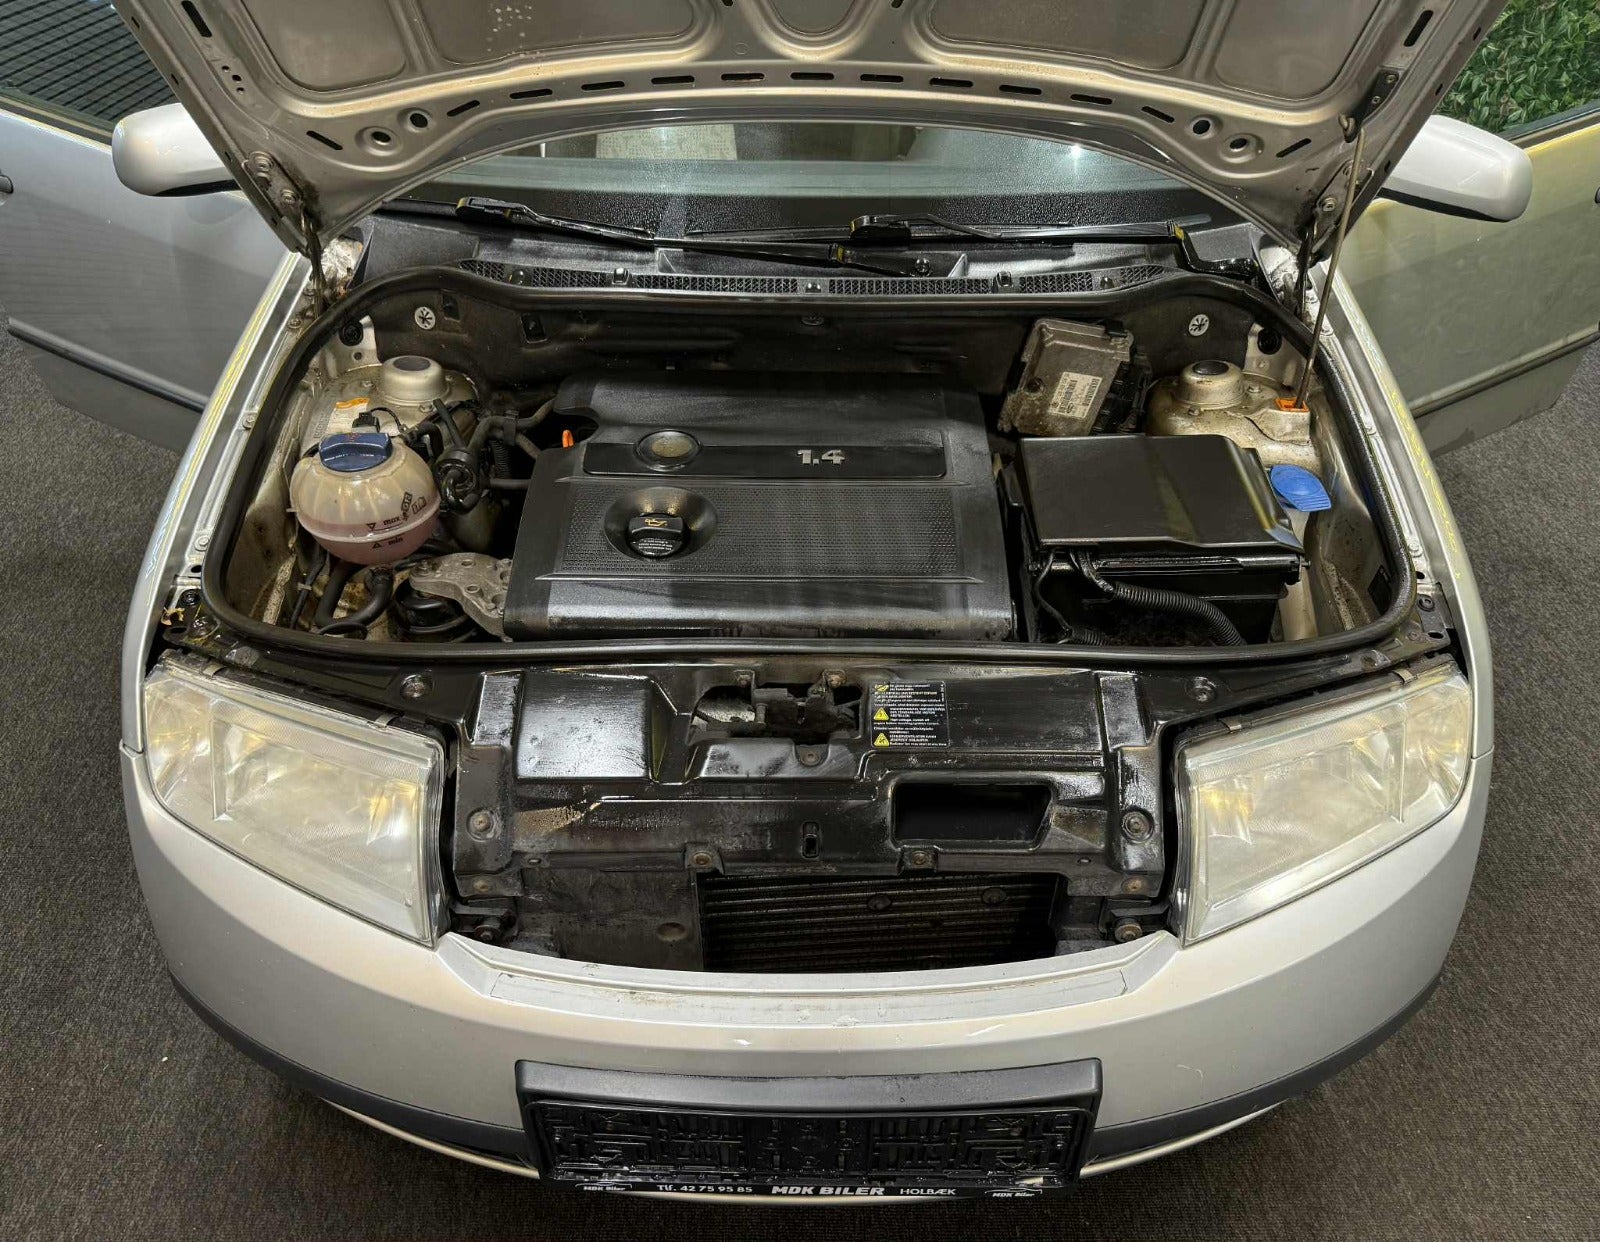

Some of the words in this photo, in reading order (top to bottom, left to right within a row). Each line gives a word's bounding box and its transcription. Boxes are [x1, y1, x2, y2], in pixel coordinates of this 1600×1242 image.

[797, 449, 845, 465] 1.4
[383, 516, 400, 525] max
[388, 536, 404, 545] min
[771, 1185, 814, 1195] MDK
[819, 1186, 885, 1196] BILER
[900, 1188, 956, 1196] HOLBÆK
